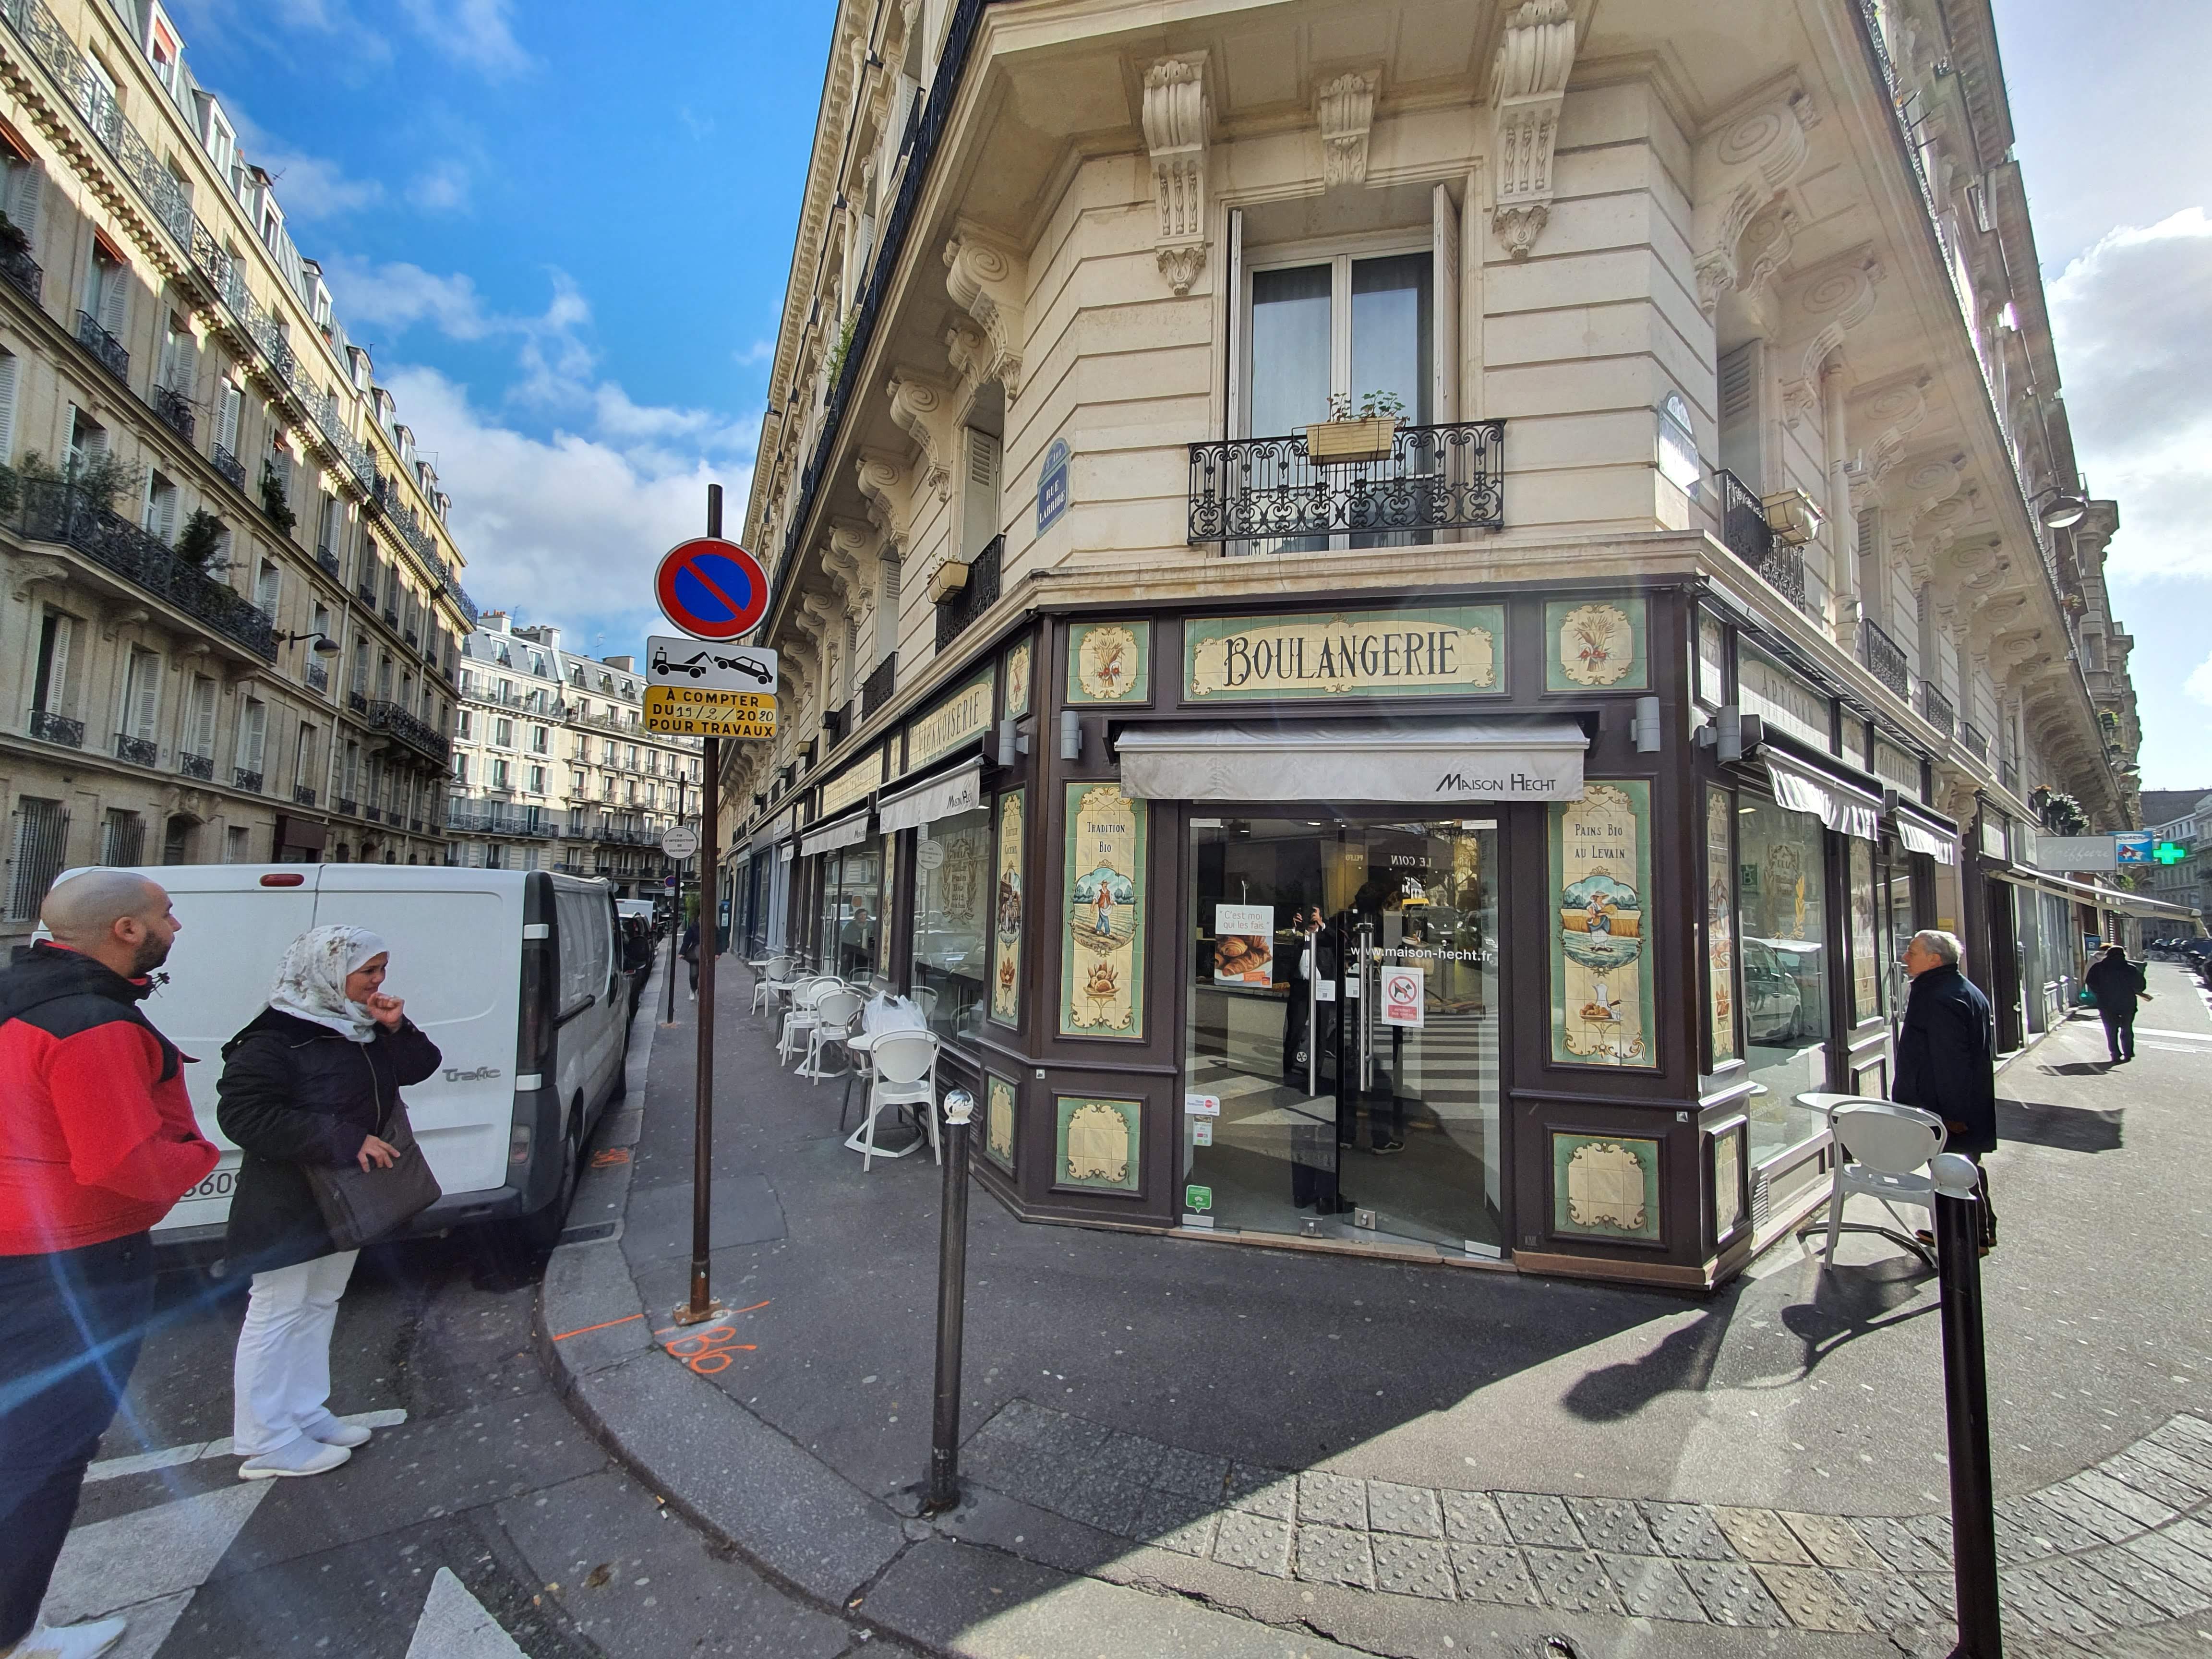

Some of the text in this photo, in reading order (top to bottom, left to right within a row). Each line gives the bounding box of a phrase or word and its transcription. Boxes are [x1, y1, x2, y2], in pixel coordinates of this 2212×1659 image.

[1046, 479, 1059, 502] RUE
[1039, 490, 1065, 523] LARRIBE
[1223, 630, 1459, 687] BOULANGERIE
[666, 688, 759, 707] À COMPTER
[653, 704, 673, 715] DU
[649, 719, 773, 737] POUR TRAVAUX
[919, 691, 980, 754] VIENNOISERIE
[1436, 773, 1556, 792] MAISON HECHT
[1087, 821, 1125, 833] TRADITION
[1575, 824, 1623, 836] PAINS BIO
[1099, 841, 1111, 853] BIO
[1575, 845, 1625, 858] AU LEVAIN
[1248, 912, 1262, 920] moi
[442, 1066, 501, 1082] Trafic
